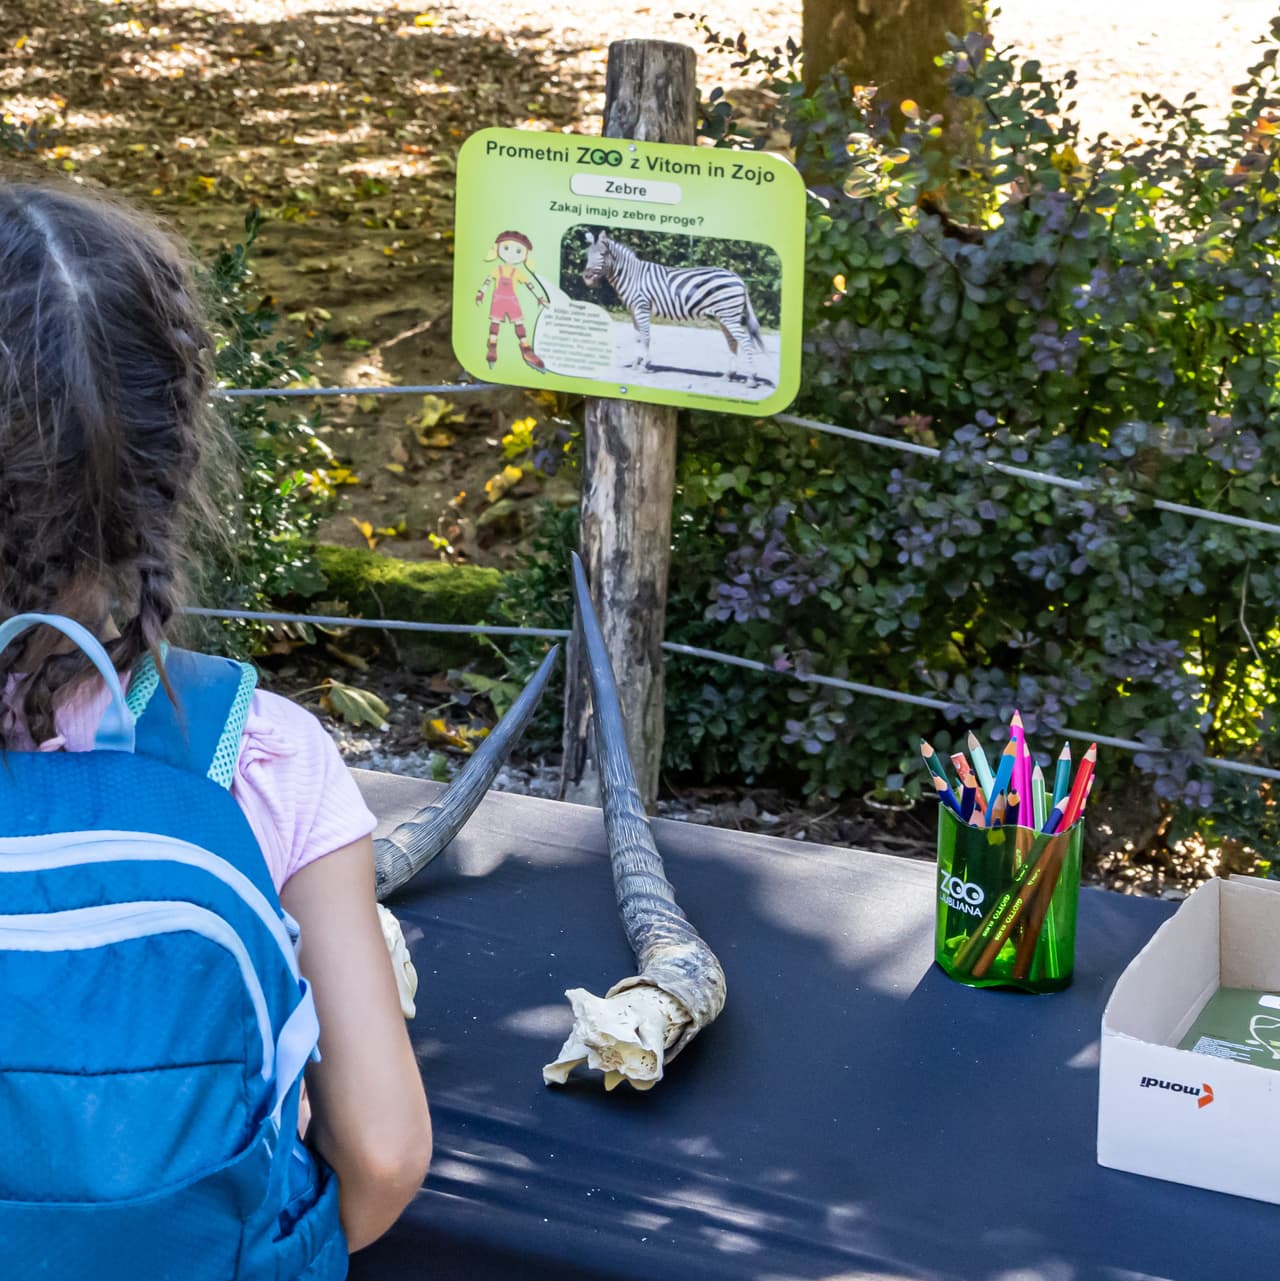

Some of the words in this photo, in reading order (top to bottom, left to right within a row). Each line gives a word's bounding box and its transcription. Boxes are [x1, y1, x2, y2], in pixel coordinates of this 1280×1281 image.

[486, 140, 569, 163] Prometni
[576, 146, 623, 167] ZOO
[630, 157, 640, 170] z
[646, 155, 701, 176] Vitom
[708, 161, 725, 178] in
[731, 164, 776, 186] Zojo
[605, 180, 647, 197] Zebre
[549, 200, 582, 217] Zakaj
[586, 205, 619, 220] imajo
[622, 210, 657, 222] zebre
[660, 214, 705, 228] proge?
[940, 868, 985, 905] ZOO
[1139, 1075, 1201, 1097] mondi
